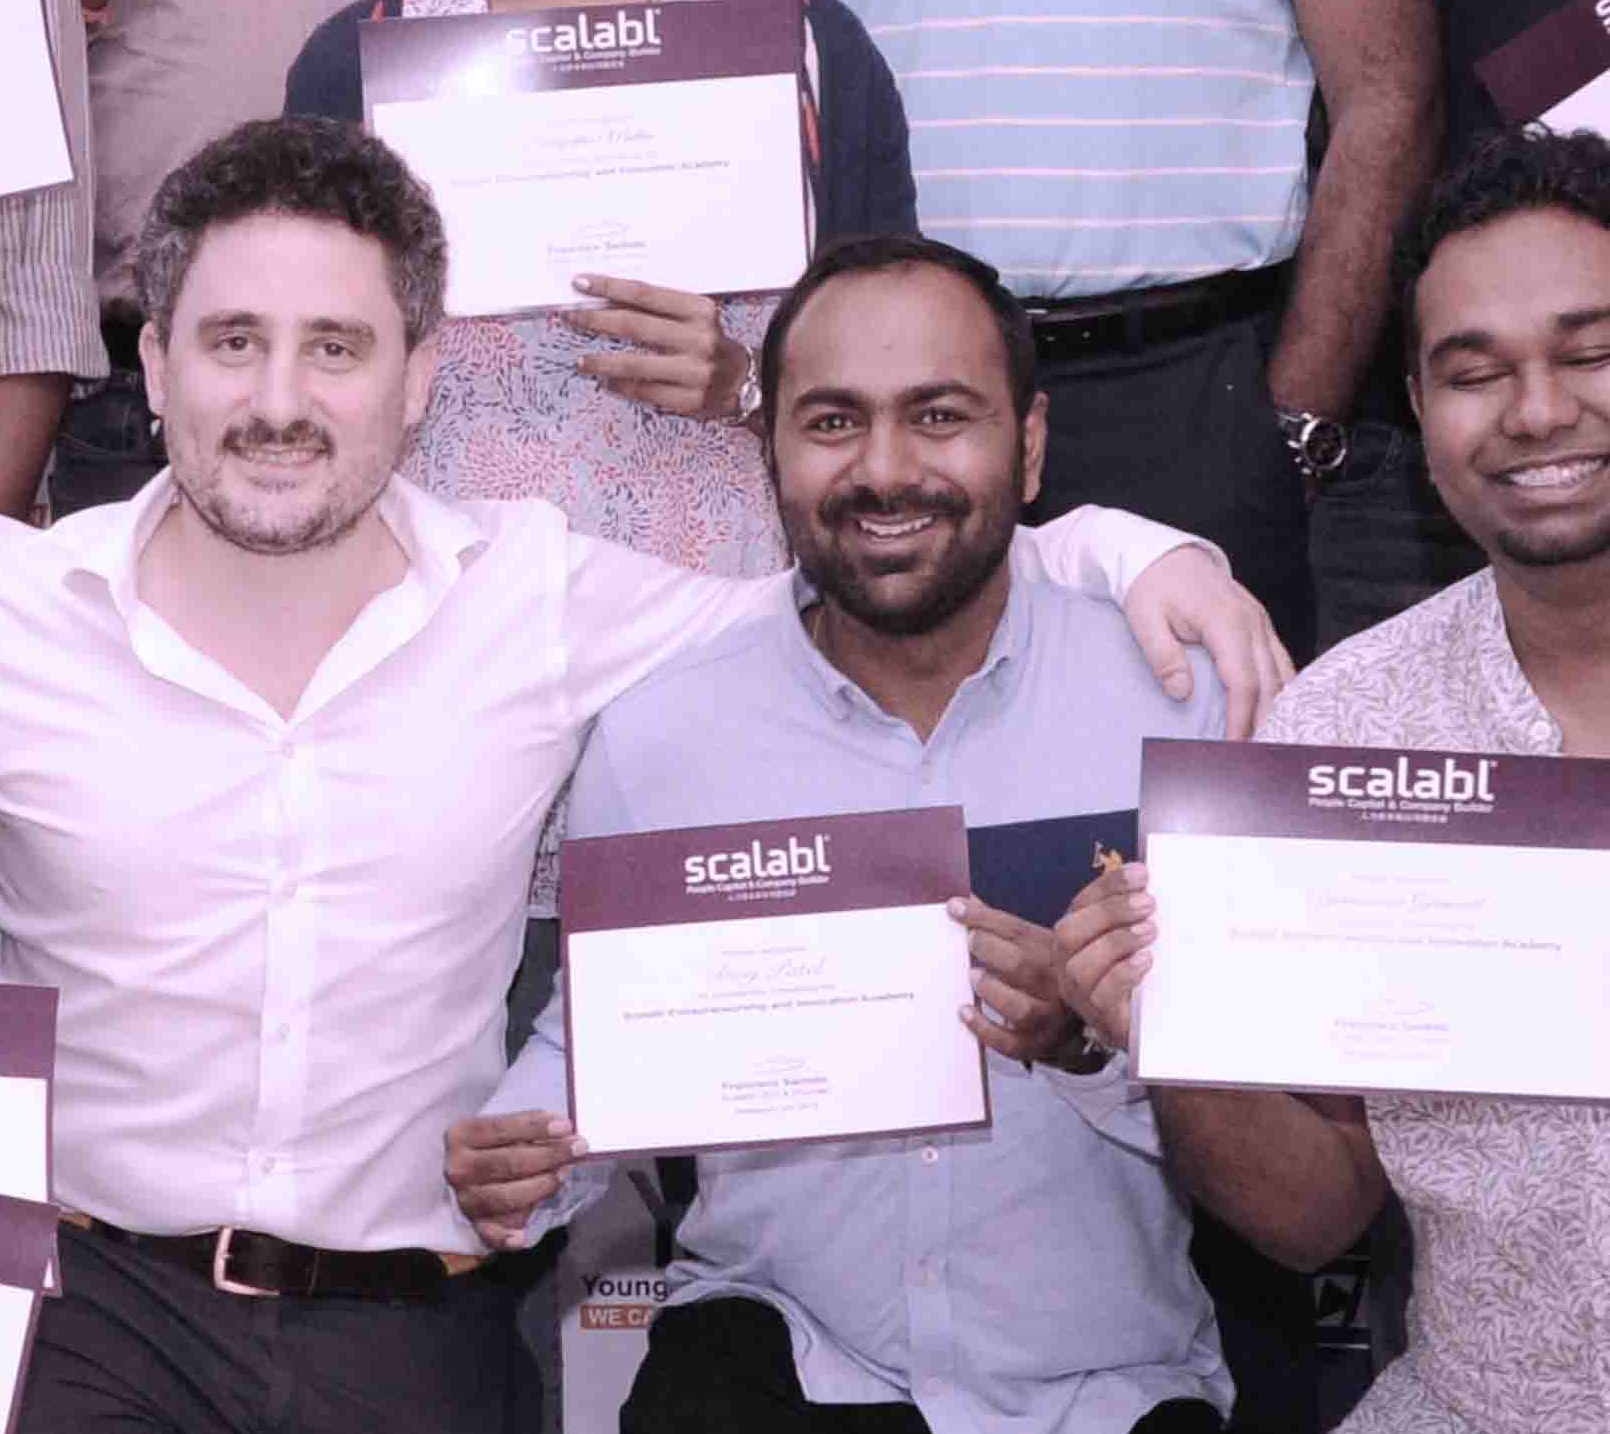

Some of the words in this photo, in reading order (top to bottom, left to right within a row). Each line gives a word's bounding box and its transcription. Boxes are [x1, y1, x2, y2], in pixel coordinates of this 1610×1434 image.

[508, 9, 662, 52] scalabl
[1308, 756, 1494, 801] scalabl
[685, 835, 831, 883] scalabl
[581, 1274, 666, 1302] Young
[589, 1309, 619, 1325] WE
